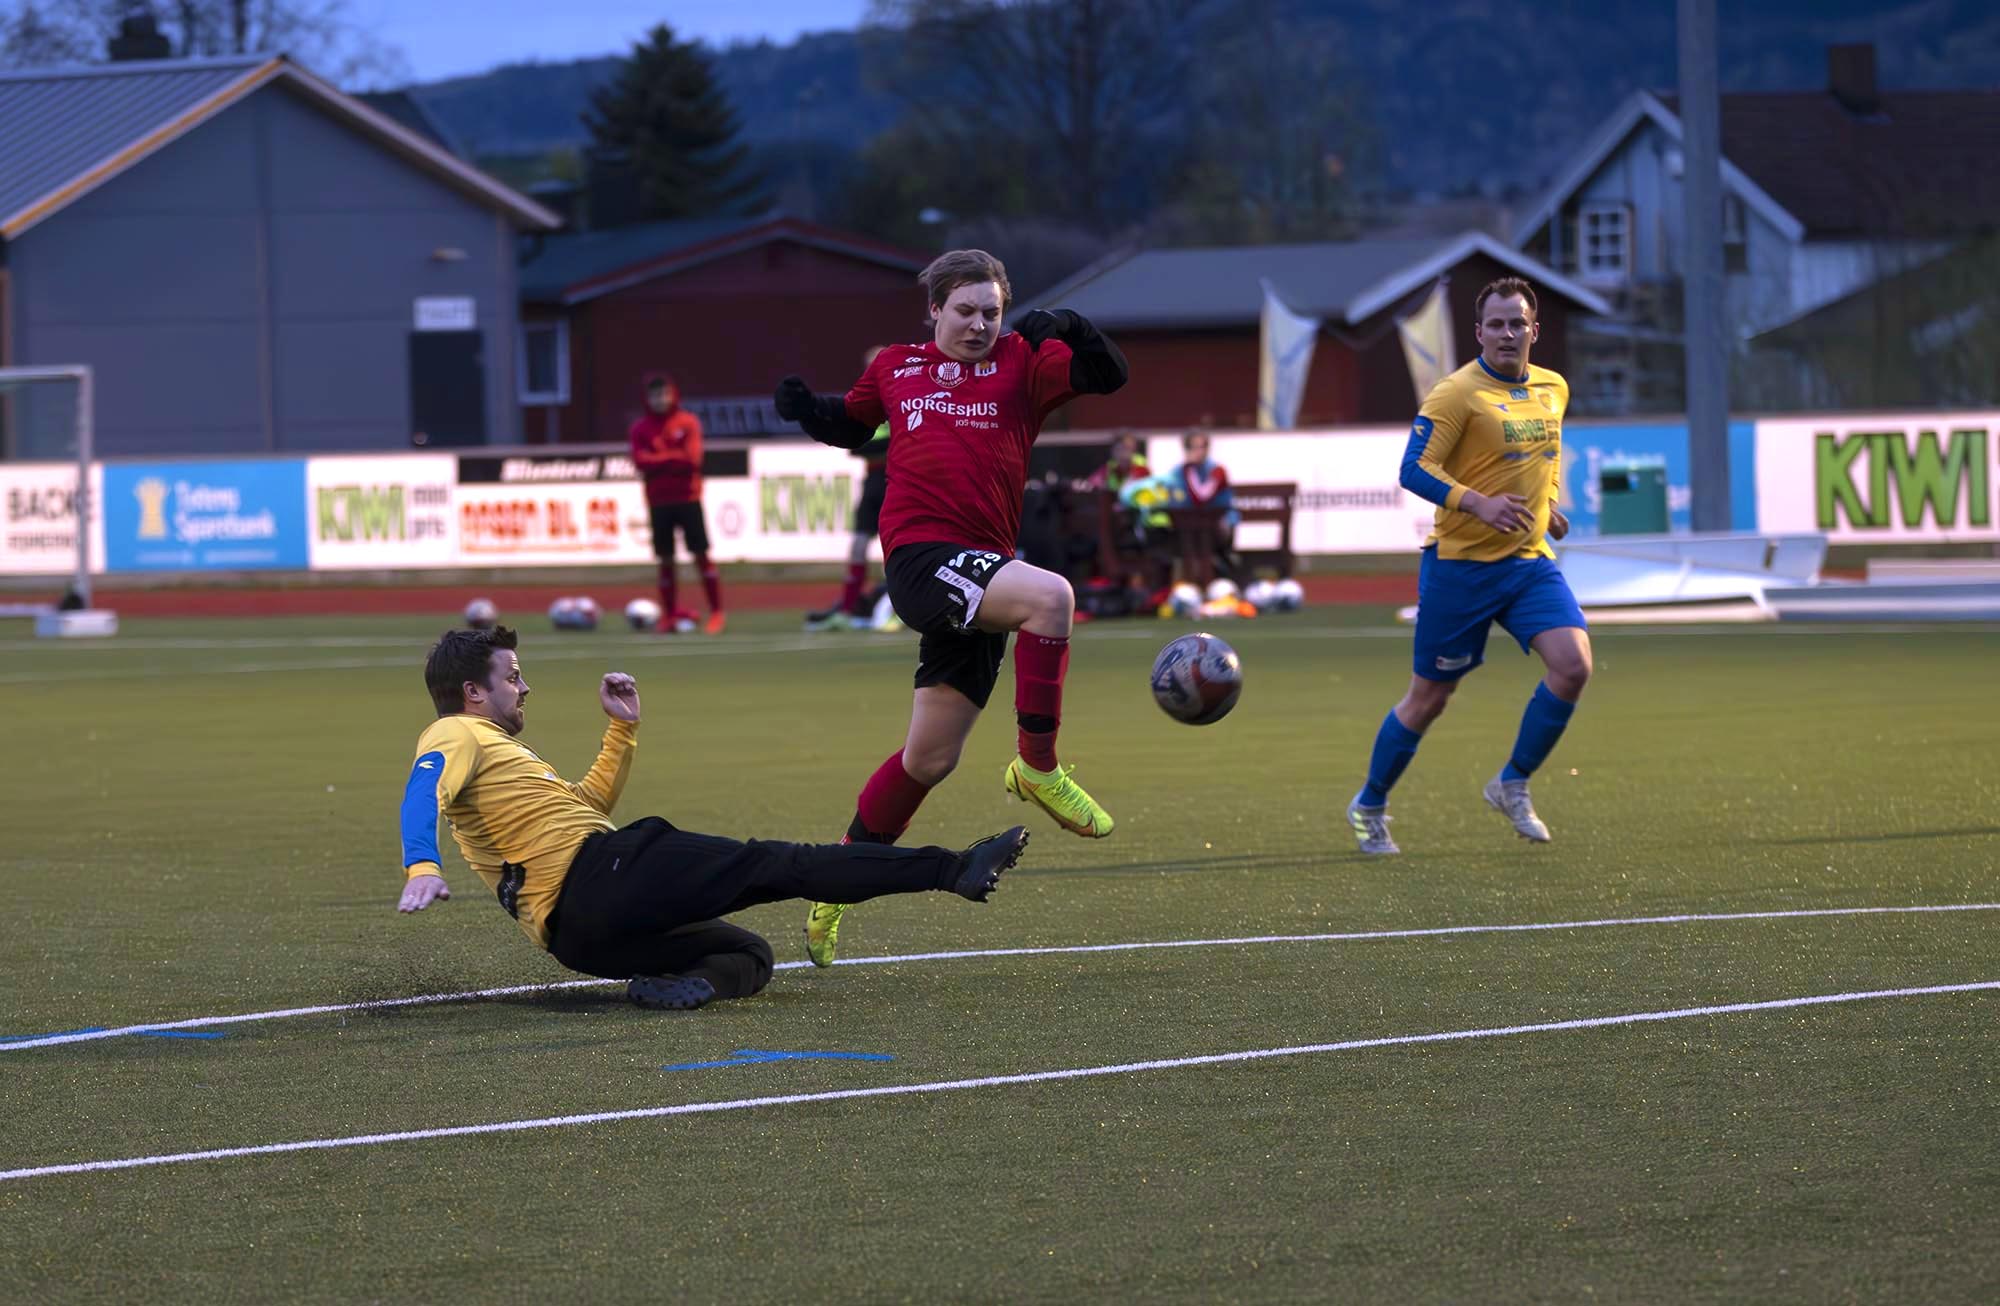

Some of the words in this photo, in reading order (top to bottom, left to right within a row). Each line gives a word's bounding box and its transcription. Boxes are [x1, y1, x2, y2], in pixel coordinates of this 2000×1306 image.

[900, 398, 998, 417] NORGESHUS
[760, 474, 856, 533] KIWI
[1814, 431, 1990, 528] KIWI
[317, 485, 405, 541] KIWI
[972, 553, 1001, 571] 29
